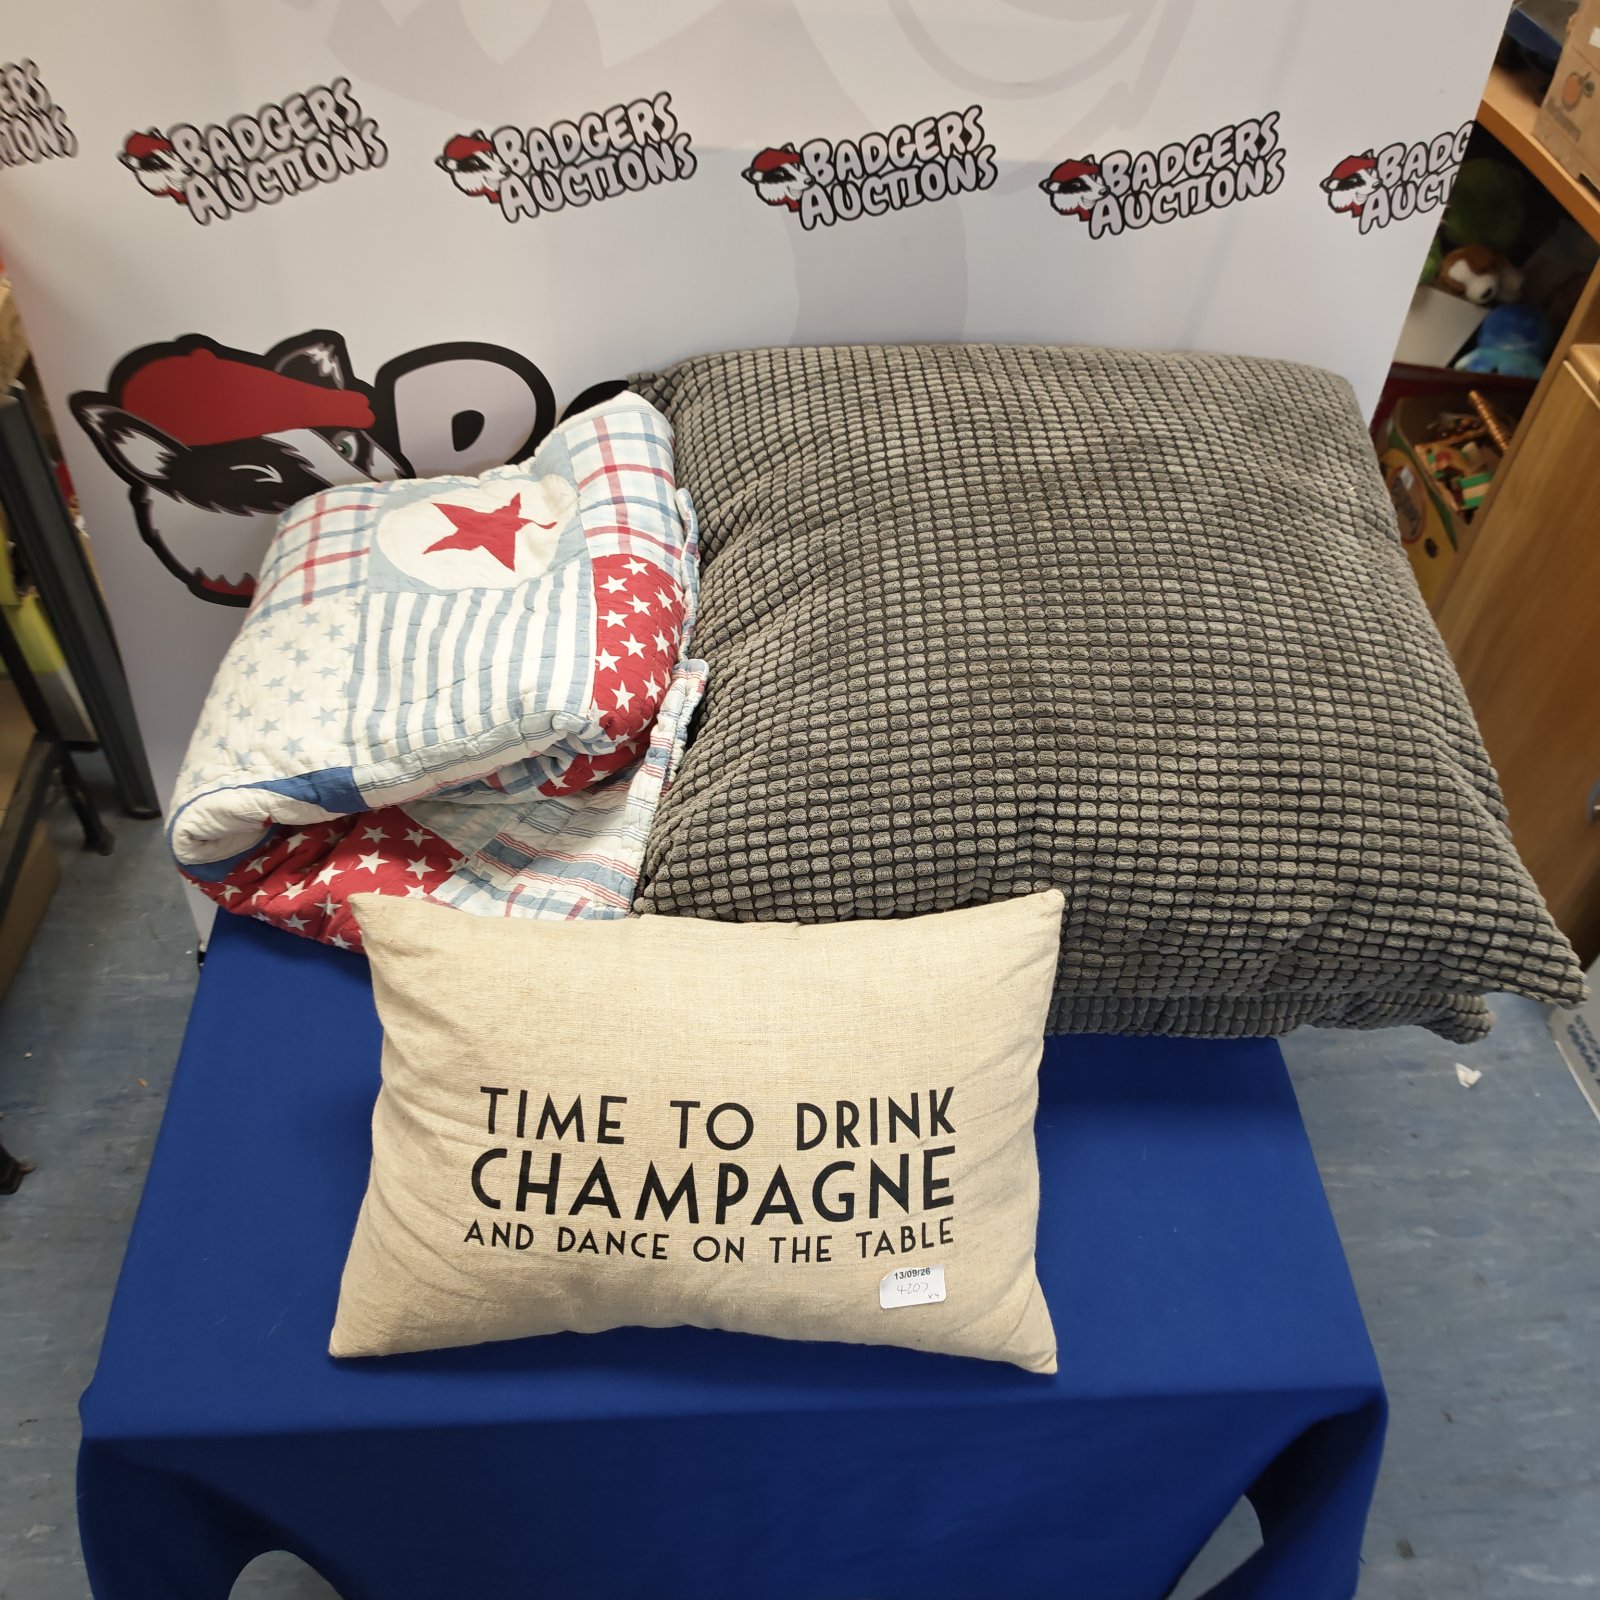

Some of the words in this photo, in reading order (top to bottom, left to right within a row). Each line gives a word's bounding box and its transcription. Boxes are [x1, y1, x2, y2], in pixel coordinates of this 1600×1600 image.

[168, 77, 361, 177] BADGERS
[491, 92, 677, 178] BADGERS
[801, 104, 985, 187] BADGERS
[1099, 111, 1280, 198] BADGERS
[184, 118, 388, 226] AUCTIONS
[499, 132, 697, 223] AUCTIONS
[799, 144, 998, 231] AUCTIONS
[1088, 148, 1286, 240] AUCTIONS
[480, 1086, 628, 1145] TIME
[669, 1100, 754, 1151] TO
[797, 1086, 956, 1151] DRINK
[471, 1145, 956, 1225] CHAMPAGNE
[463, 1220, 535, 1251] AND
[557, 1226, 670, 1260] DANCE
[693, 1235, 745, 1264] ON
[768, 1236, 833, 1263] THE
[856, 1216, 955, 1259] TABLE
[894, 1267, 931, 1280] 13/09/26
